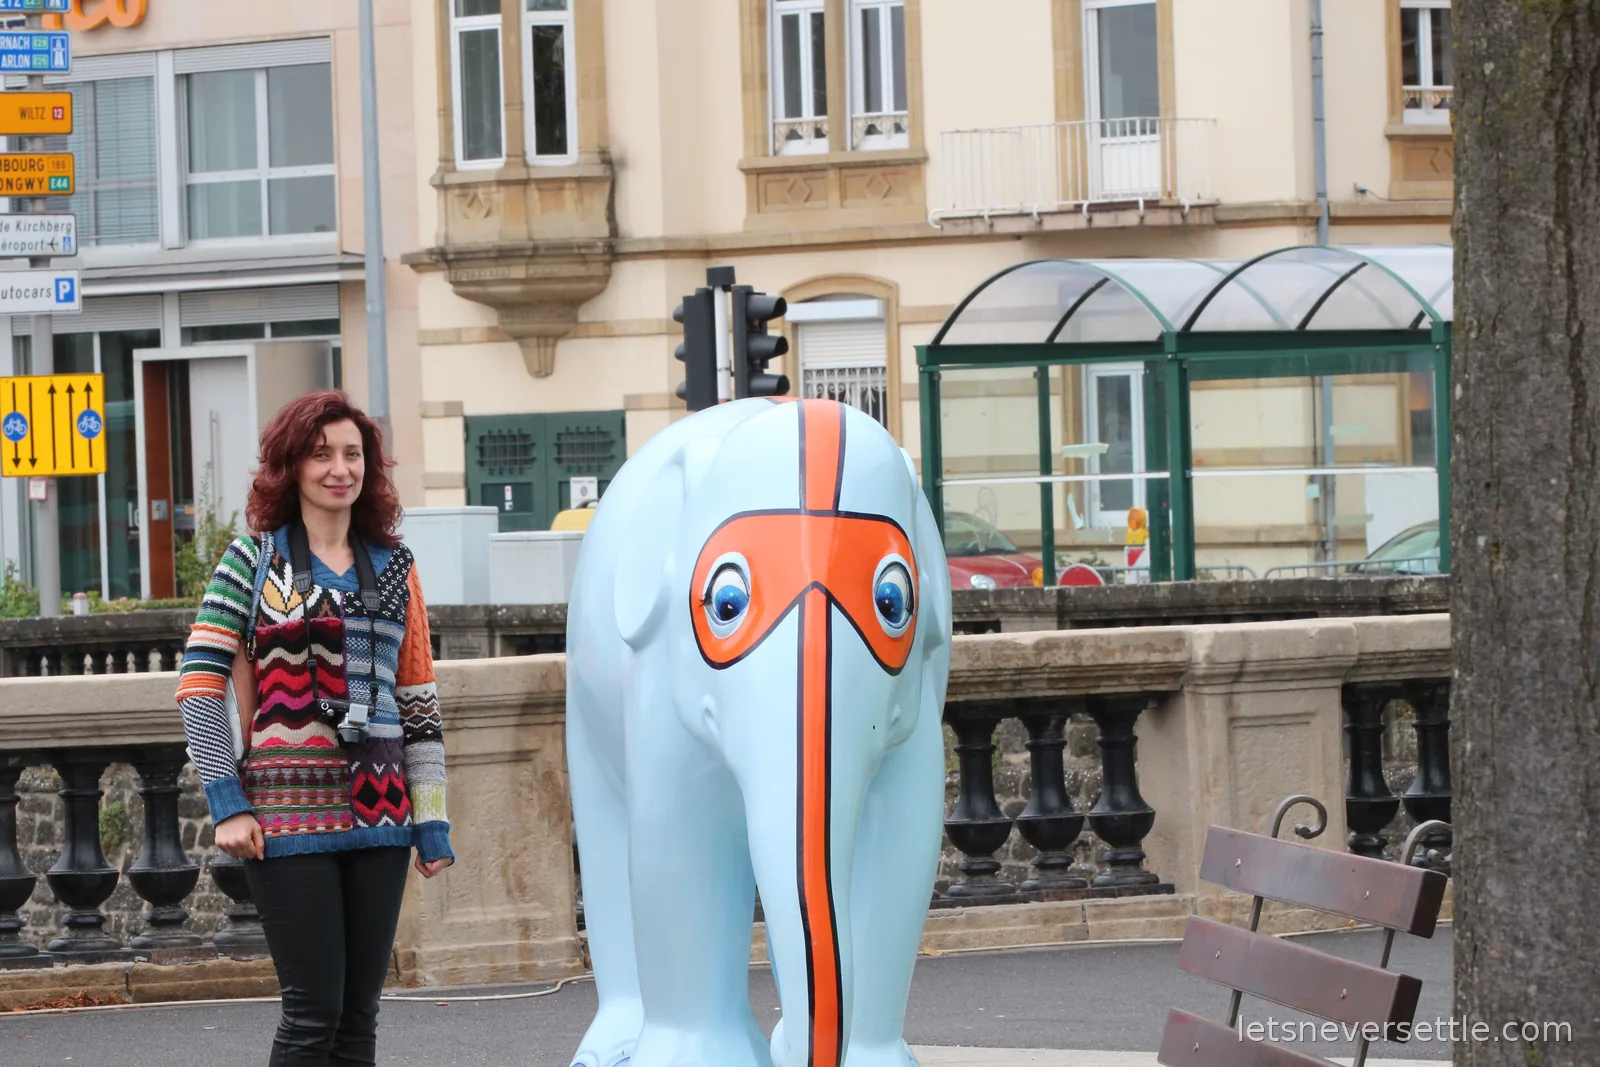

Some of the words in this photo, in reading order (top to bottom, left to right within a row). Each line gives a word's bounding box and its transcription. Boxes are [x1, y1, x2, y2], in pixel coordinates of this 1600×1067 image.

[1, 55, 30, 69] ARLON
[19, 107, 46, 120] WILTZ
[53, 108, 63, 119] 12
[52, 160, 66, 170] 186
[50, 178, 68, 189] E44
[16, 220, 72, 234] Kirchberg
[1, 285, 52, 299] utocars
